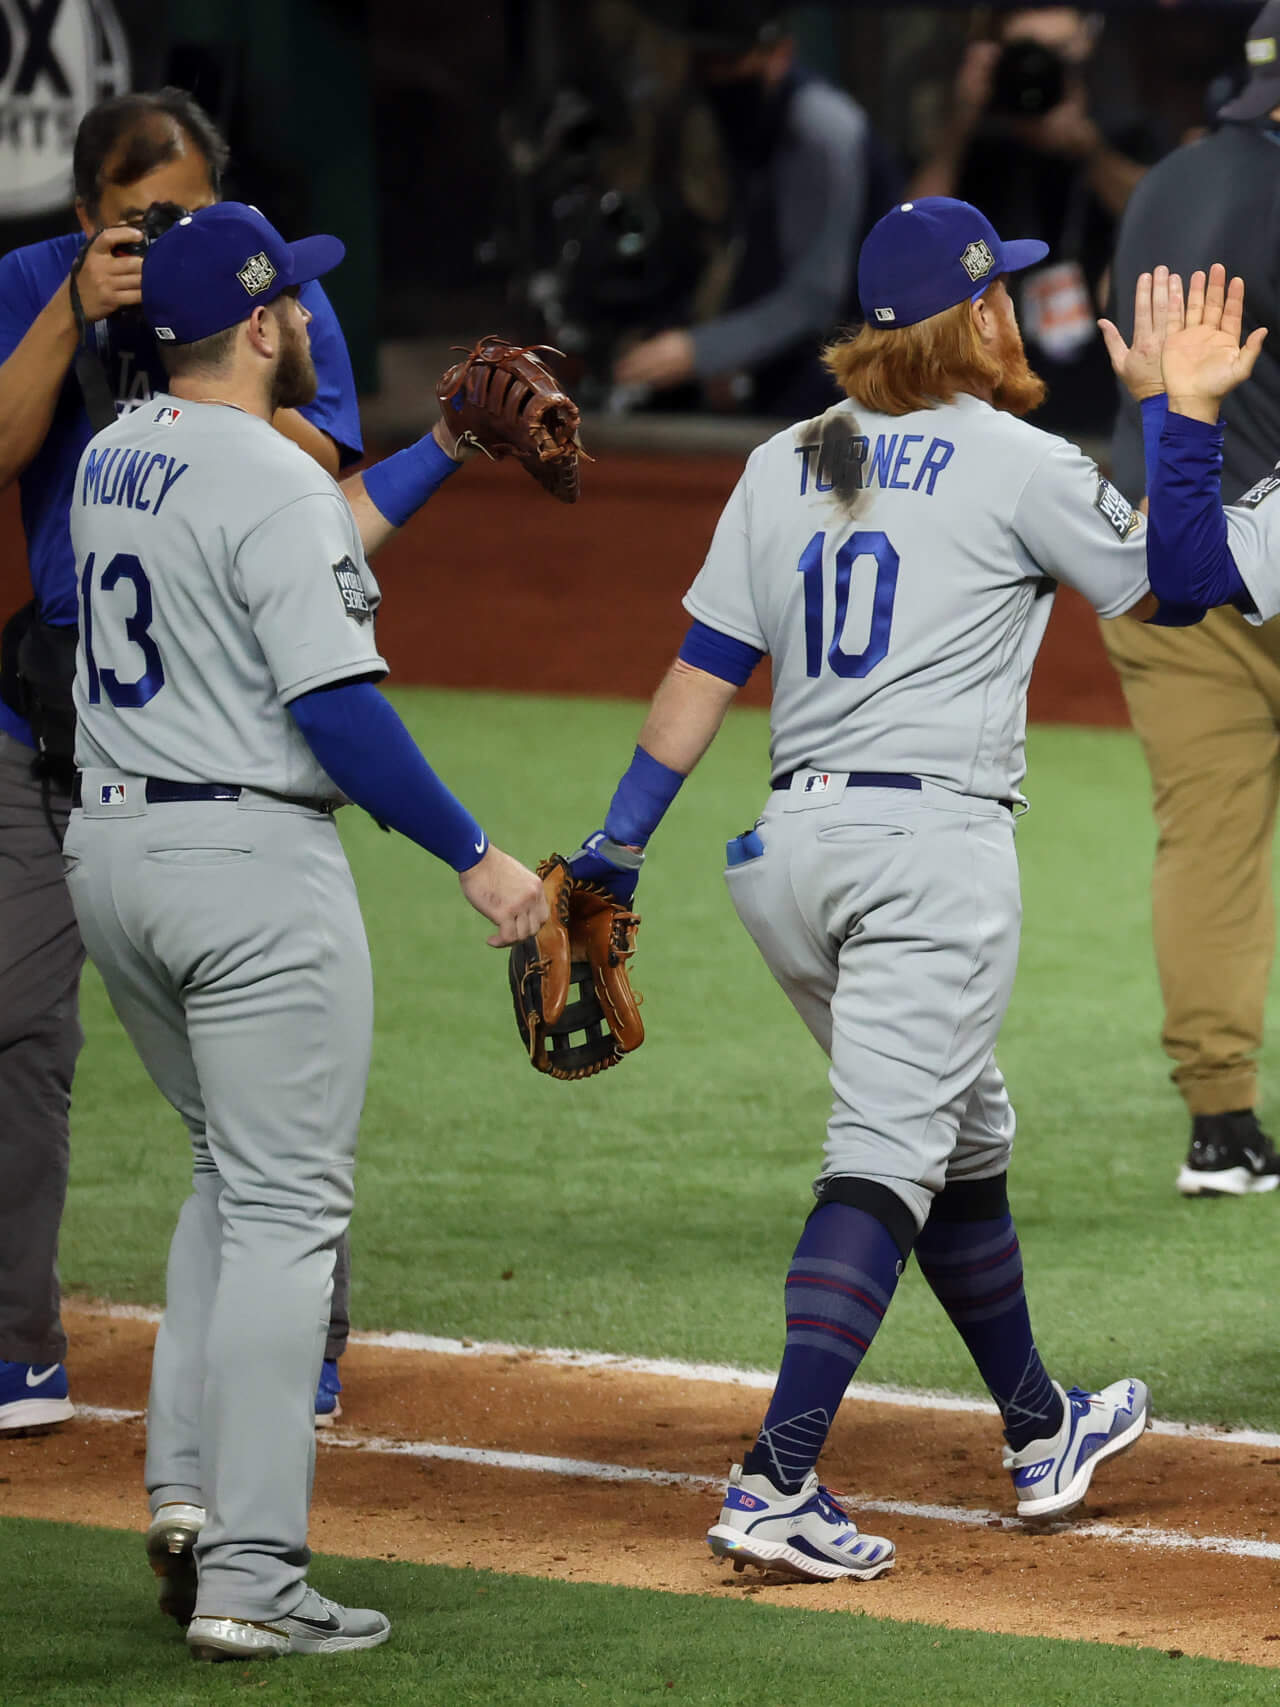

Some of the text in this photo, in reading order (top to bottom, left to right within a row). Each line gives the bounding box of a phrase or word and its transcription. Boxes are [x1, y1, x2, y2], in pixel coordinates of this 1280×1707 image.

[82, 447, 189, 517] MUNCY
[81, 551, 165, 709] 13
[796, 530, 900, 679] 10
